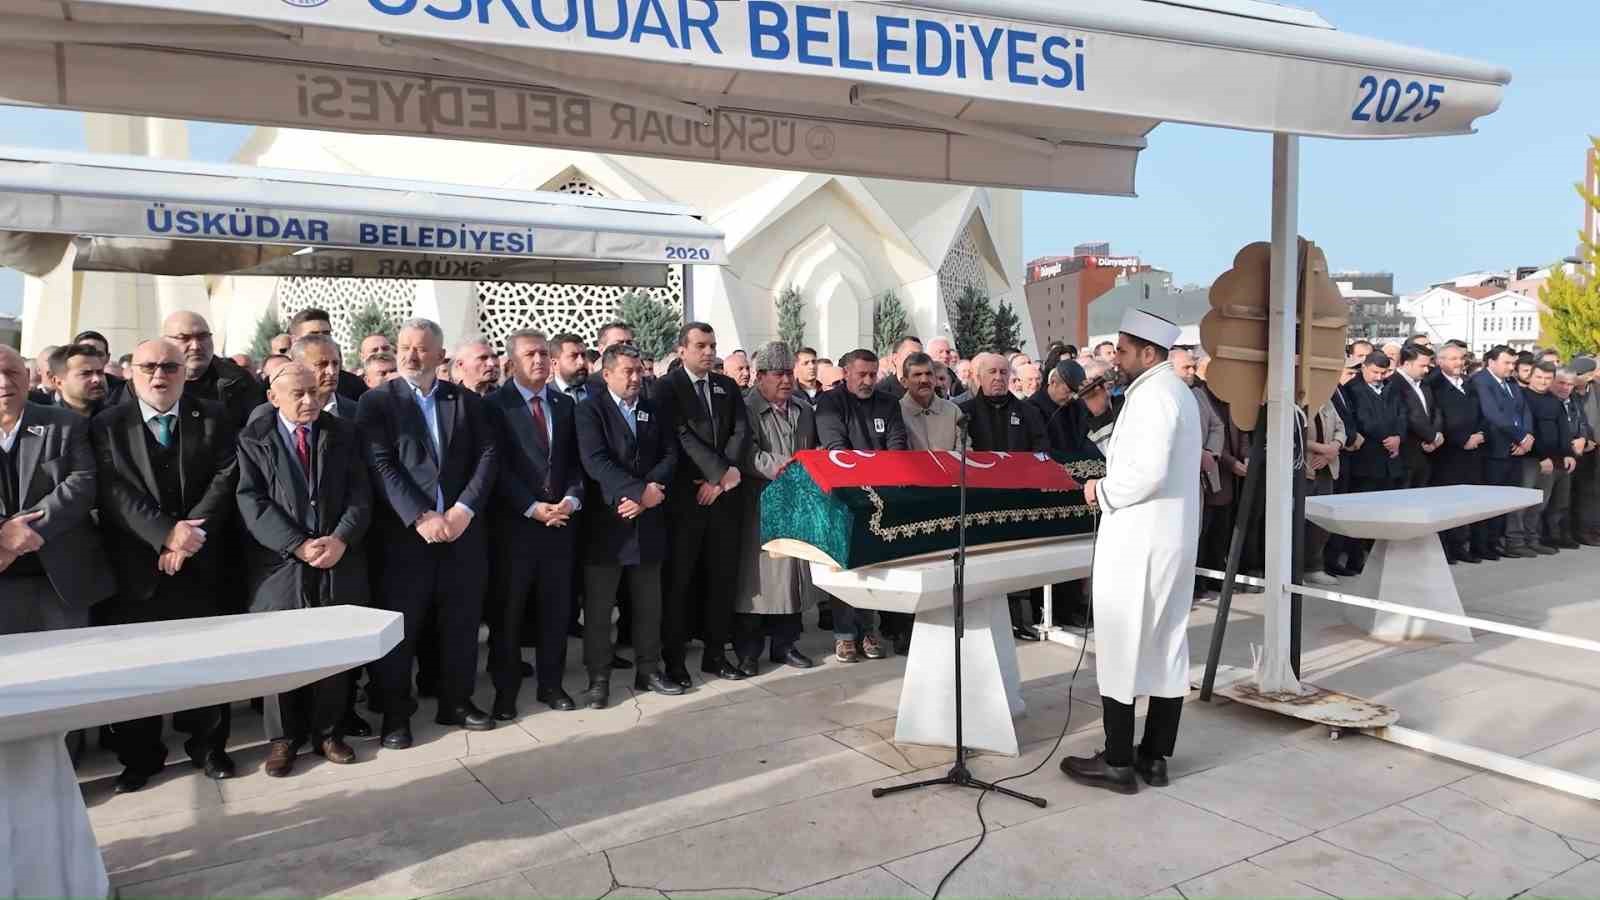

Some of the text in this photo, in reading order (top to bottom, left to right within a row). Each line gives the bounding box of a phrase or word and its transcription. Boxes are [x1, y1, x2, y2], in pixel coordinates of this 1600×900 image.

[368, 0, 721, 54] ÜDAR
[1352, 75, 1445, 122] 2025
[147, 203, 534, 253] ÜSKÜDAR BELEDİYESİ
[665, 246, 710, 260] 2020
